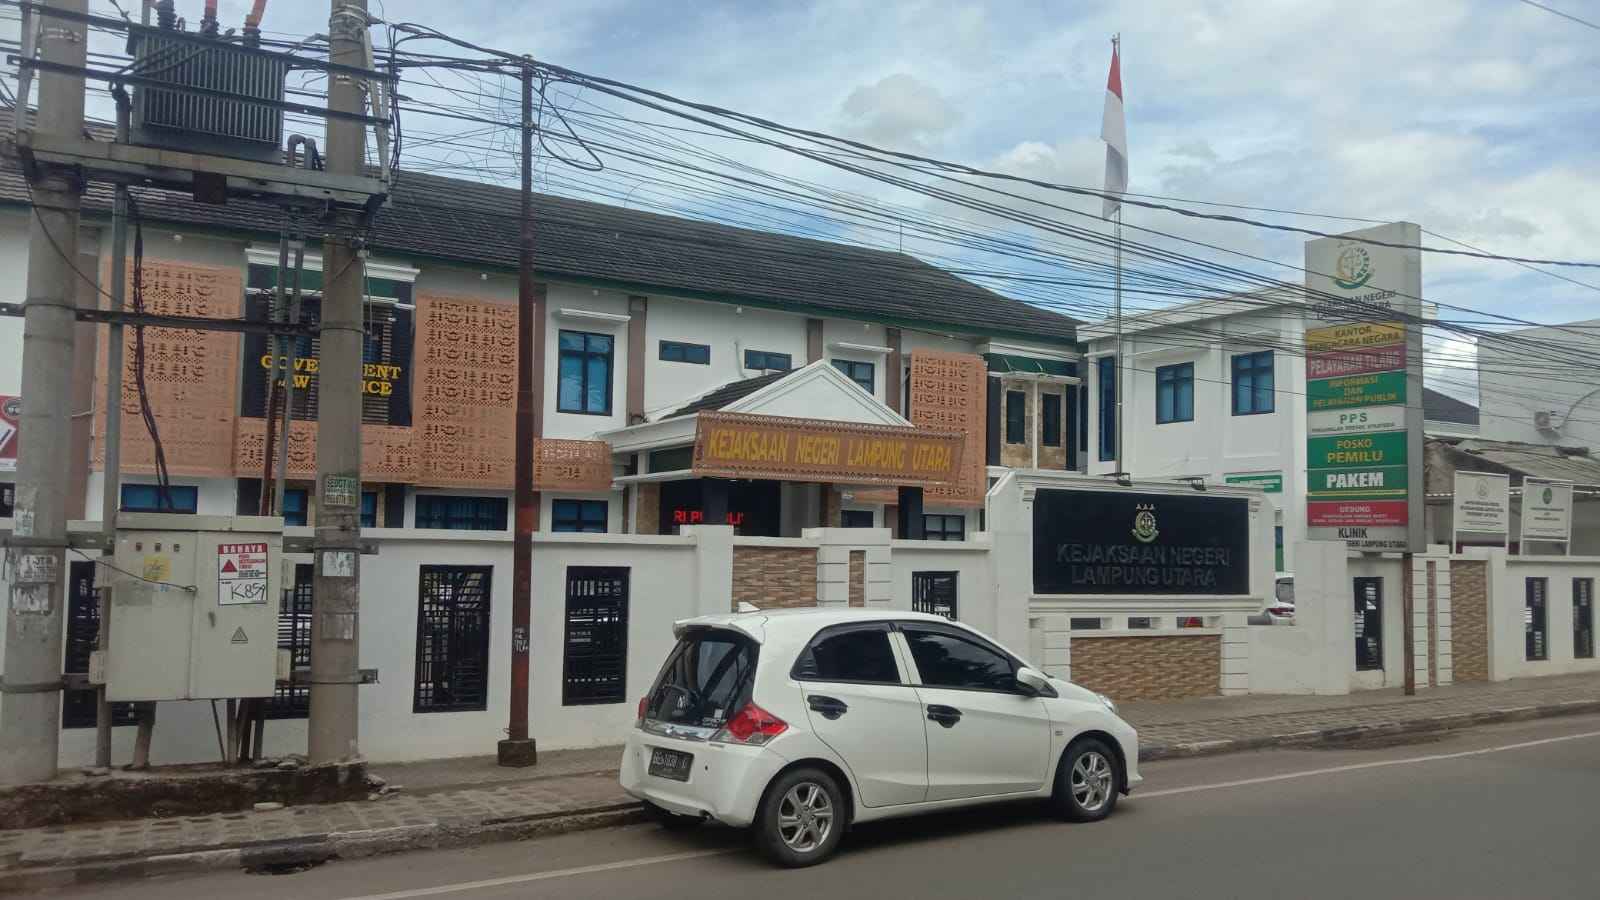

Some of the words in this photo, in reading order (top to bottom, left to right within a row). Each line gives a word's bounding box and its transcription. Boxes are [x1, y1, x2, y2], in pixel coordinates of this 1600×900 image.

[1339, 412, 1368, 425] PPS
[708, 429, 788, 462] KEJAKSAAN
[795, 434, 840, 465] NEGERI
[848, 439, 905, 471] LAMPUNG
[912, 443, 952, 472] UTARA
[1337, 439, 1373, 449] POSKO
[1327, 450, 1383, 463] PEMILU
[1327, 472, 1384, 488] PAKEM
[1338, 528, 1368, 539] KLINIK
[223, 544, 263, 554] BAHAYA
[1056, 543, 1166, 565] KEJAKSAAN
[1170, 546, 1231, 567] NEGERI
[1072, 566, 1159, 586] LAMPUNG
[1161, 567, 1217, 587] UTARA
